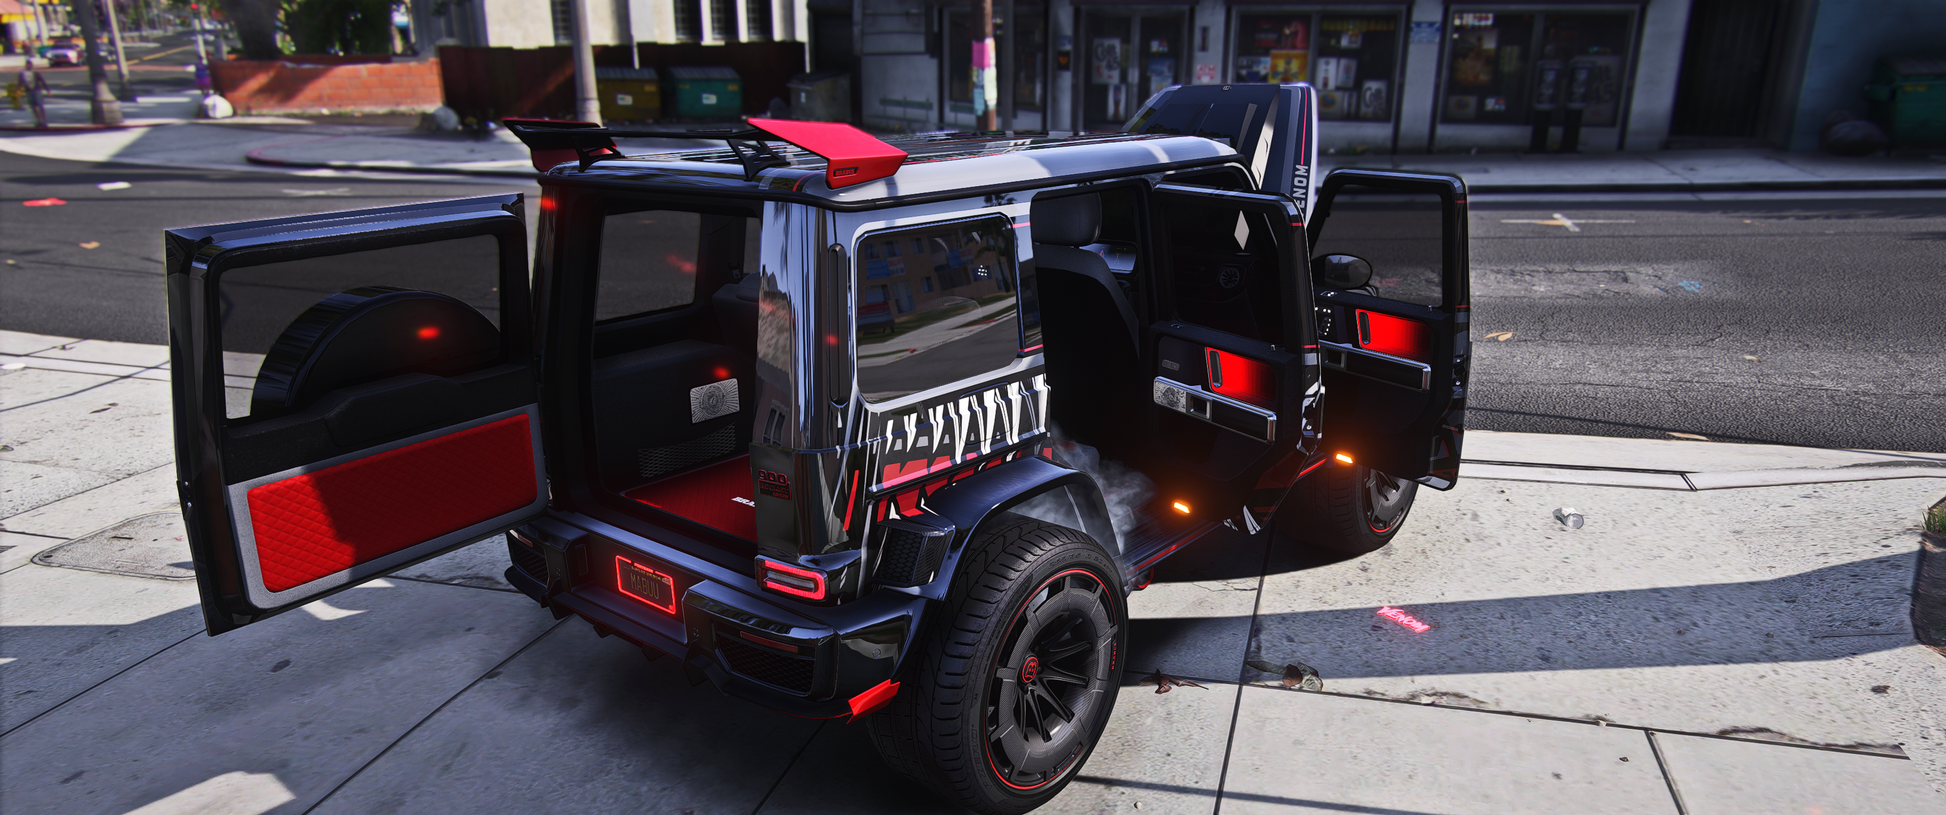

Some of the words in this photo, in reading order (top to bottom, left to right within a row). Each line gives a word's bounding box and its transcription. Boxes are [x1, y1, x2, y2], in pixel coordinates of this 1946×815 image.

[1292, 164, 1309, 213] ENOM
[758, 469, 788, 486] 900
[630, 572, 659, 600] MABUU
[1376, 605, 1431, 633] VENOM
